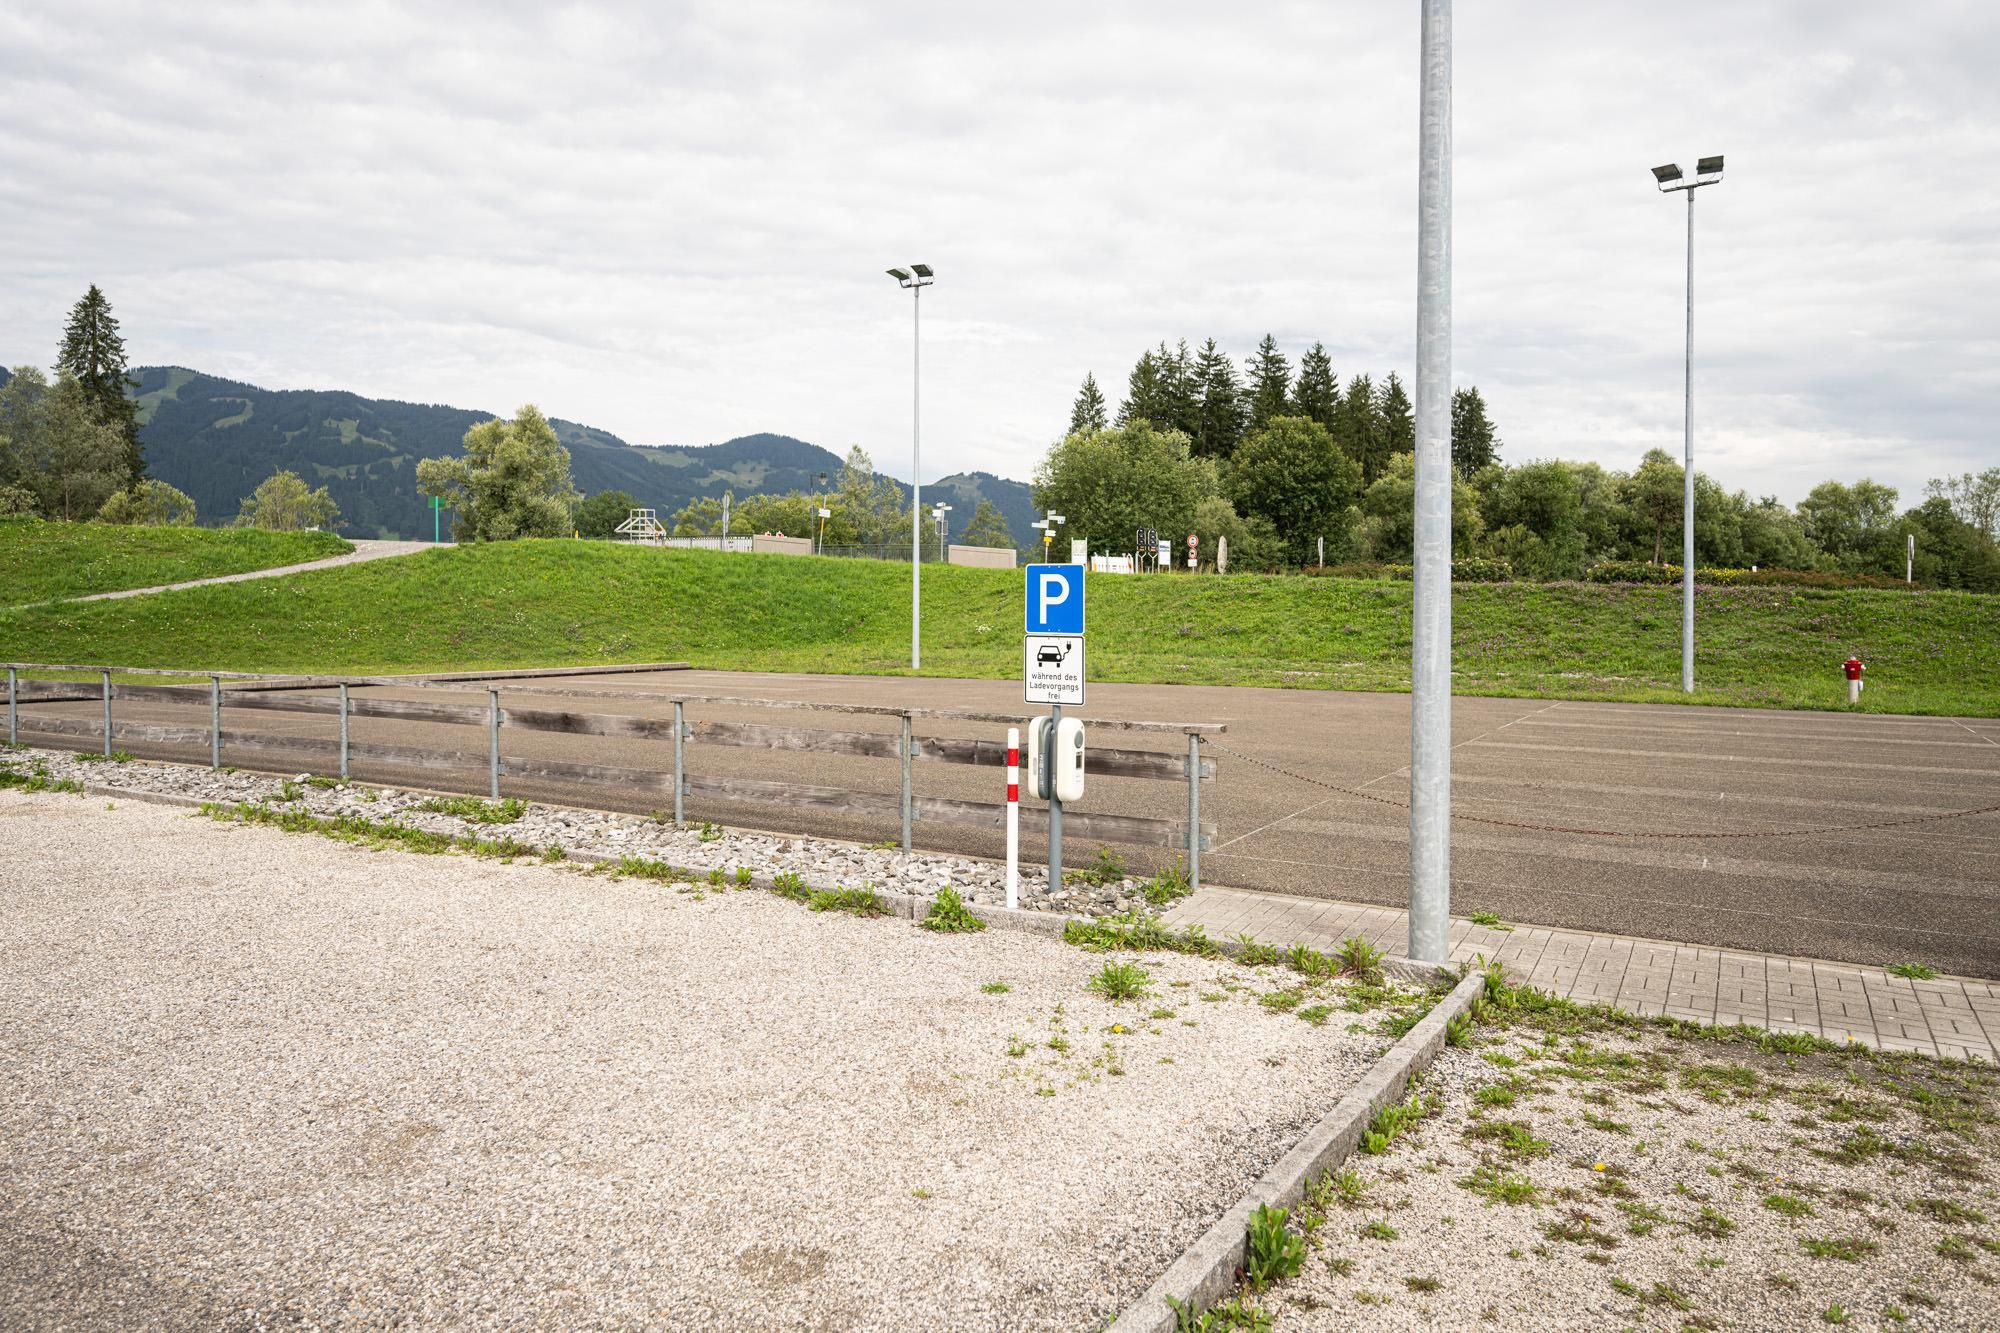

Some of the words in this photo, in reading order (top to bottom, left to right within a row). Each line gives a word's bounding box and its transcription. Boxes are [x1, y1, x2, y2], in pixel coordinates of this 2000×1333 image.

[1039, 573, 1070, 625] P
[1031, 672, 1062, 681] während
[1064, 673, 1078, 681] des
[1029, 682, 1080, 692] Ladevorgangs
[1048, 691, 1061, 700] frei
